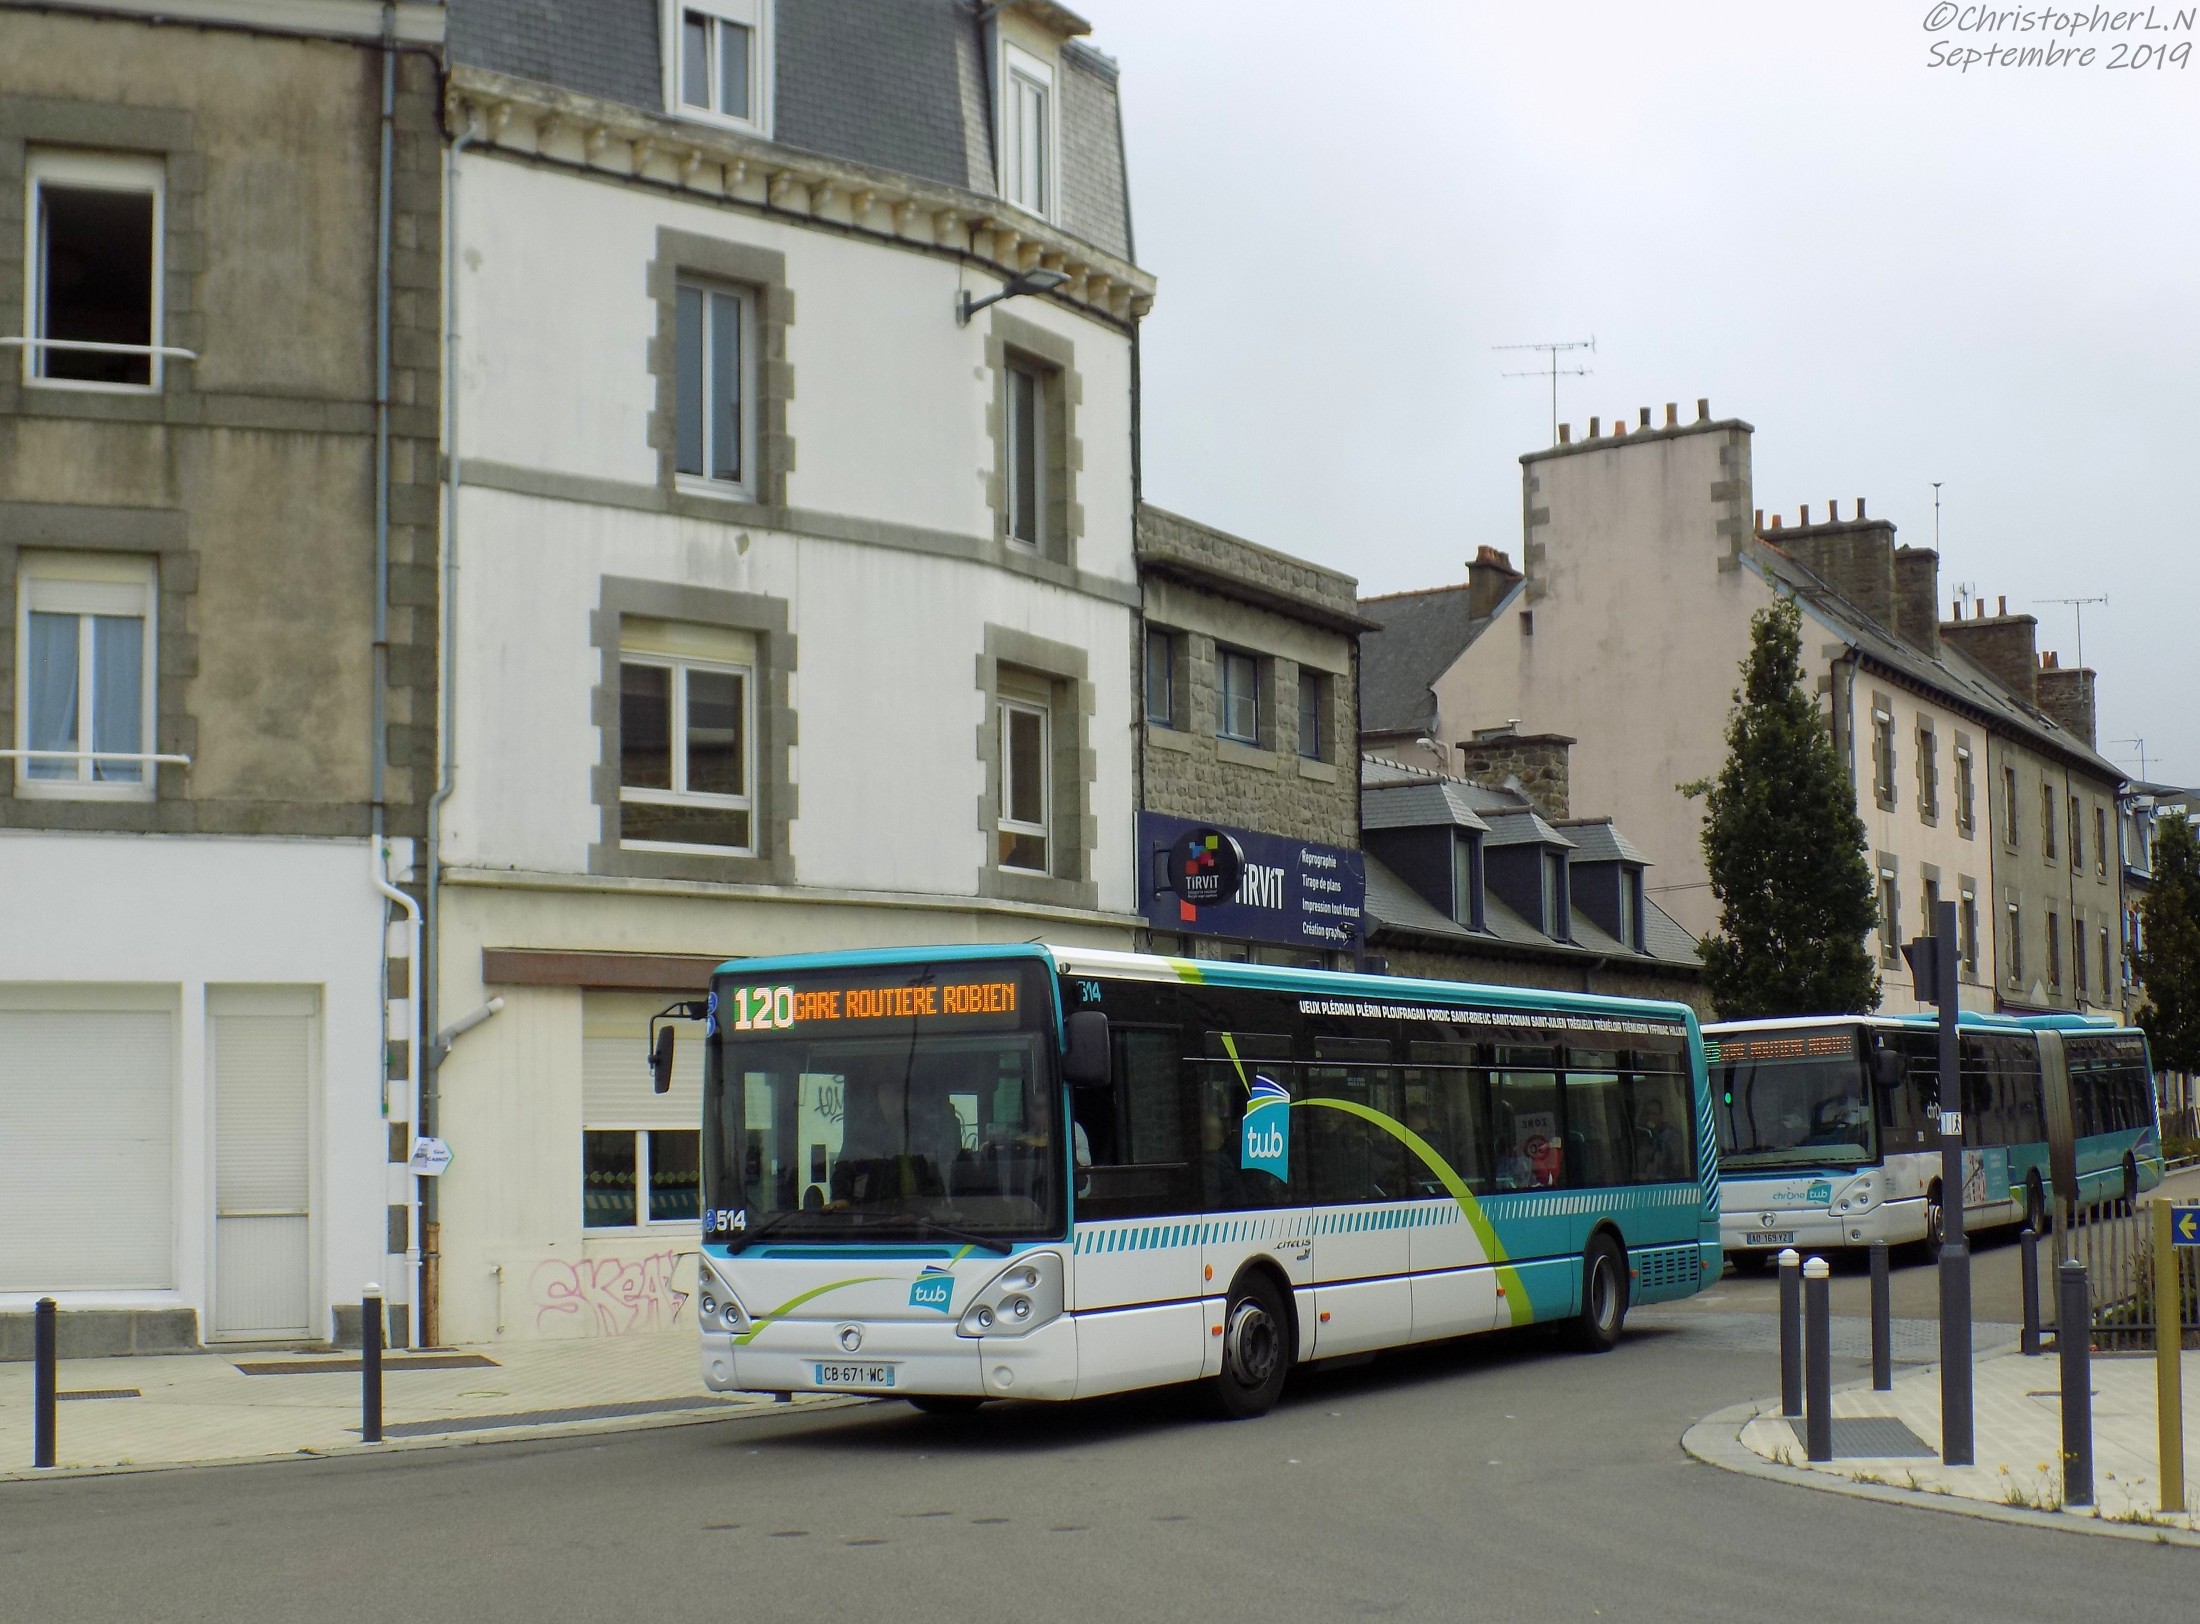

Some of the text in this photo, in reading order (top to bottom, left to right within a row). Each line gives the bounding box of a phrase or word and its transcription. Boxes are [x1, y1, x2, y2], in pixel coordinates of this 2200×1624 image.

[1301, 850, 1337, 869] Reprographie
[1302, 873, 1341, 893] Tirage de plans
[1302, 897, 1360, 918] Impression tout format
[1302, 921, 1325, 937] Création
[734, 982, 1015, 1030] 120 GARE ROUTIERE ROBIEN
[1321, 999, 1355, 1017] PLÉDRAN
[1355, 1001, 1381, 1018] PLÉRIN
[1382, 1005, 1426, 1021] PLOUFRAGAN
[1426, 1008, 1450, 1022] PORDIC
[1450, 1010, 1492, 1025] SAINT-BRIEUC
[1247, 1121, 1283, 1158] tub
[1809, 1189, 1828, 1199] tub
[716, 1209, 746, 1231] 514
[915, 1284, 947, 1303] tub
[824, 1366, 884, 1382] CB-671-WC
